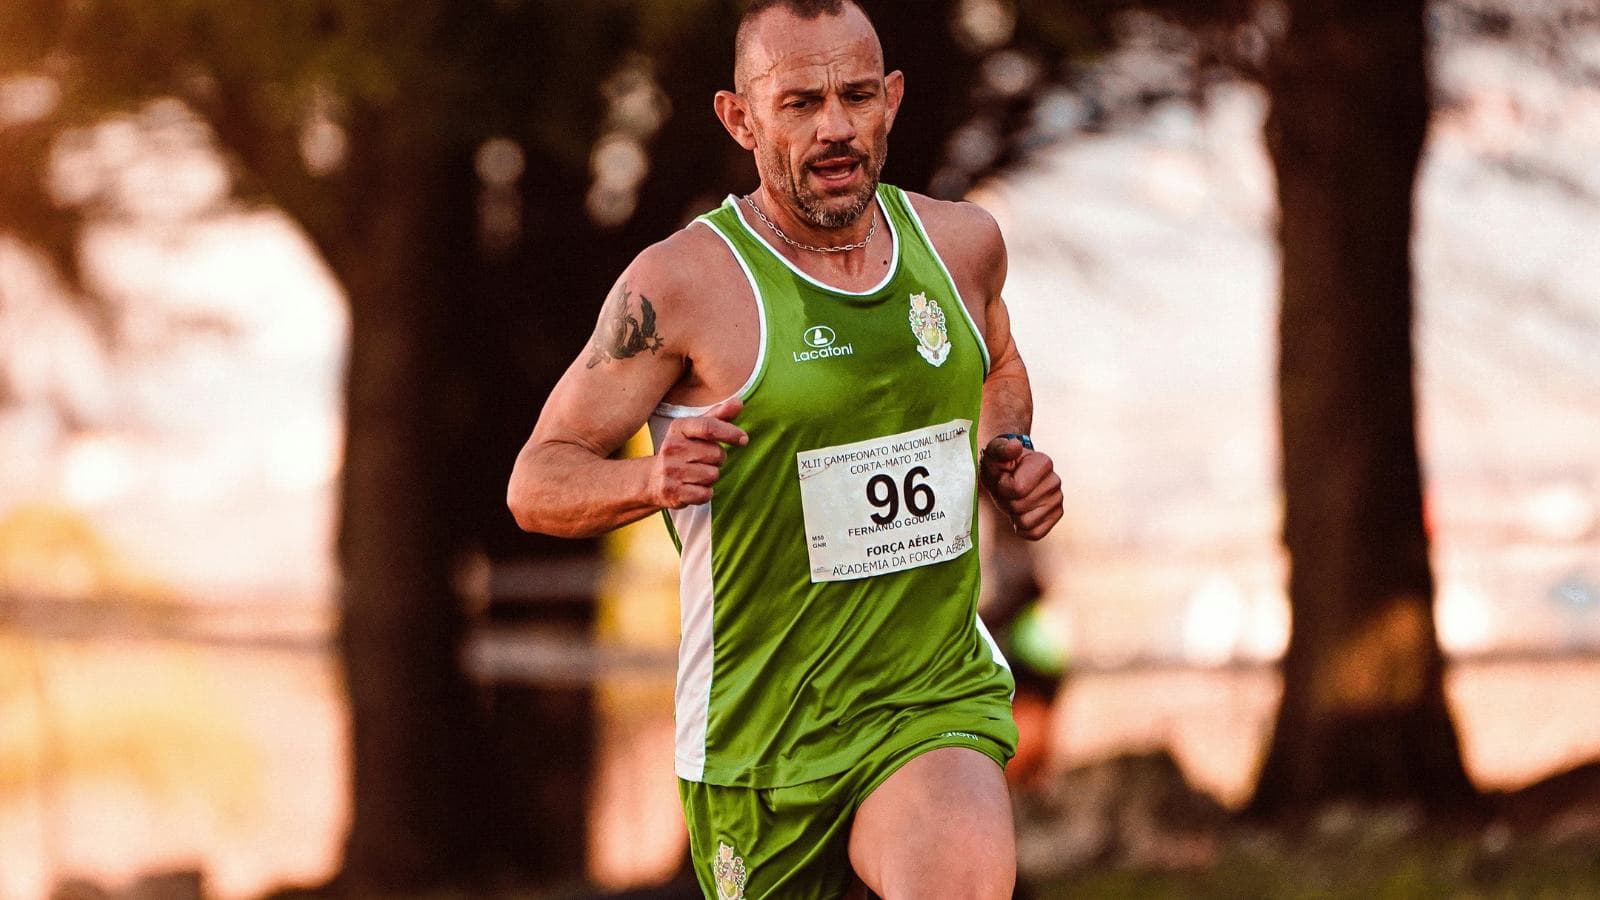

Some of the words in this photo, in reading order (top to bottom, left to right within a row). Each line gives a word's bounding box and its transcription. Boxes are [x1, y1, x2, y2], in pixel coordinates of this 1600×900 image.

[793, 343, 853, 362] Lacatoni
[801, 458, 821, 469] XLII
[824, 446, 889, 464] CAMPEONATO
[892, 436, 933, 453] NACIONAL
[850, 455, 911, 474] CORTA-MATO
[914, 450, 932, 462] 2021
[866, 466, 935, 525] 96
[848, 520, 902, 537] FERNANDO
[904, 510, 946, 527] GOUVEIA
[866, 541, 905, 557] FORÇA
[908, 532, 944, 548] AÉREA
[832, 559, 889, 576] ACADEMIA
[892, 555, 906, 567] DA
[909, 547, 943, 563] FORÇA
